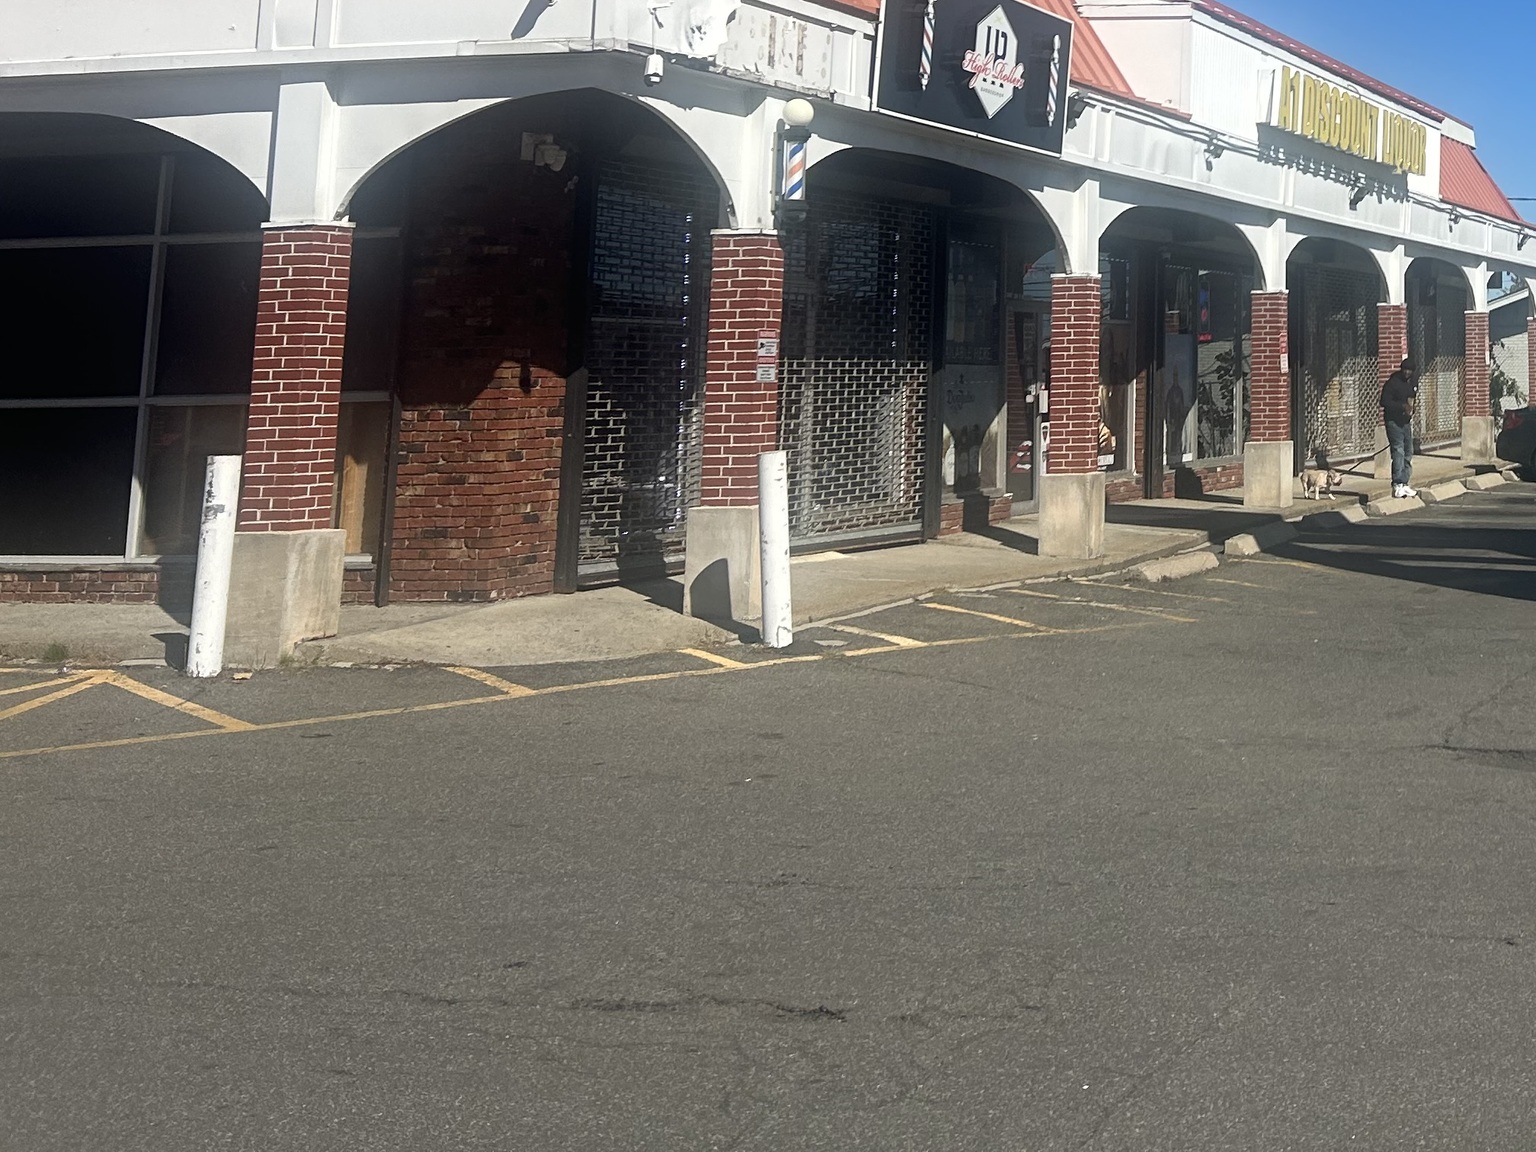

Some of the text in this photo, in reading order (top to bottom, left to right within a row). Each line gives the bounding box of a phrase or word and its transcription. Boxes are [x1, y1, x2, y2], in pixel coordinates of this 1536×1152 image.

[962, 51, 1024, 88] High Rollers
[1279, 65, 1427, 177] A1 DISCOUNT LIQUOR
